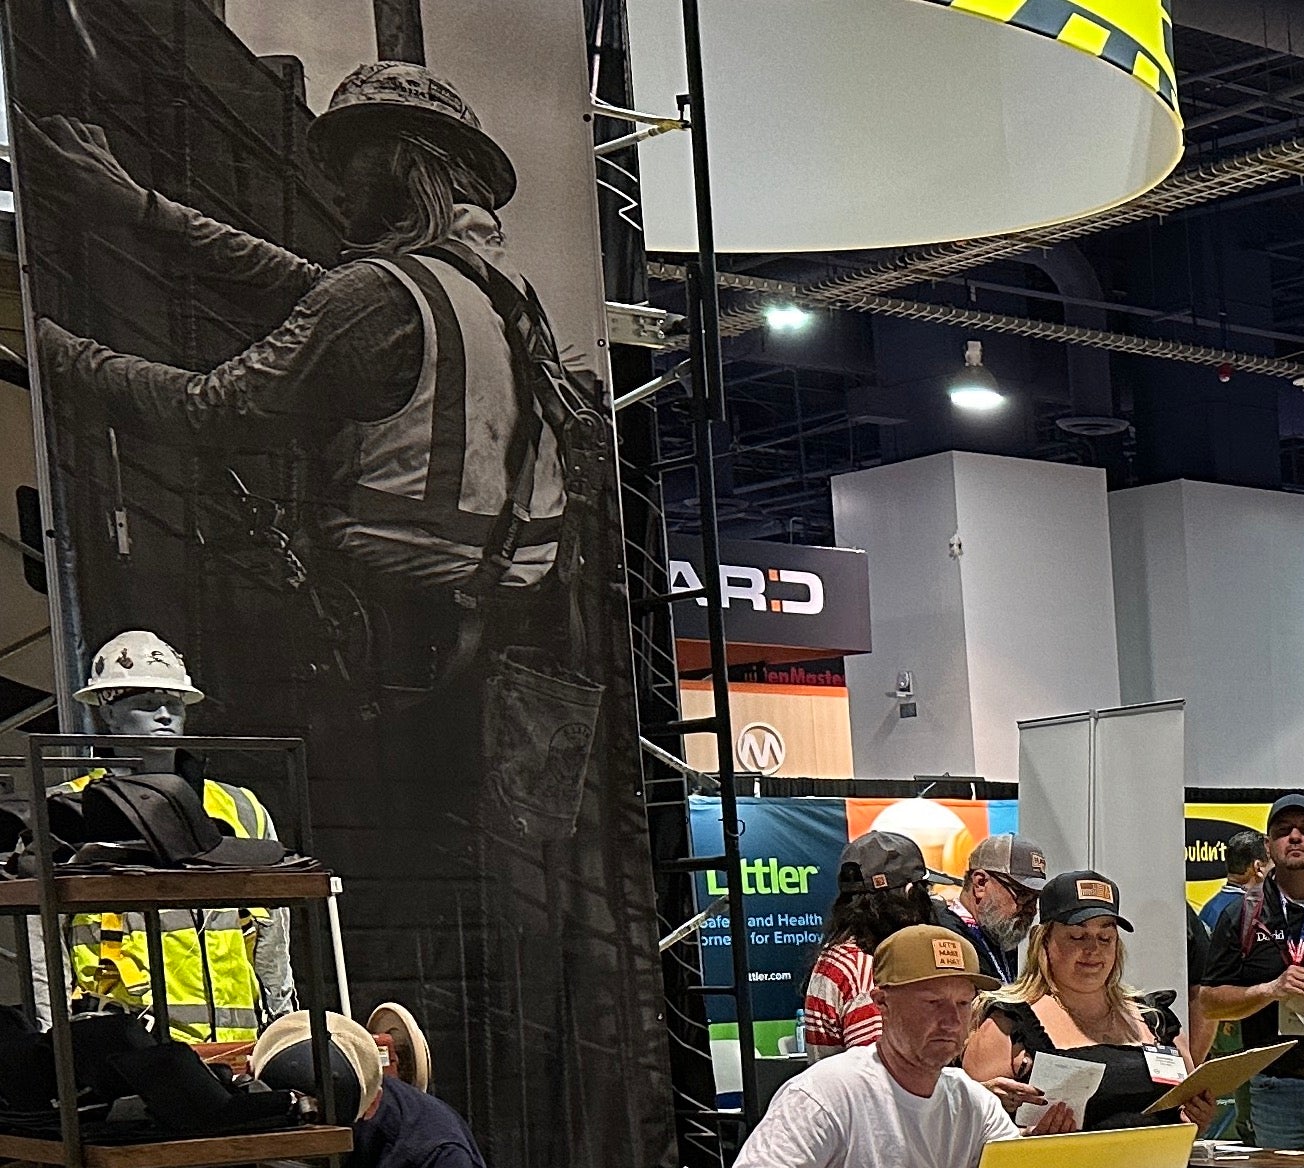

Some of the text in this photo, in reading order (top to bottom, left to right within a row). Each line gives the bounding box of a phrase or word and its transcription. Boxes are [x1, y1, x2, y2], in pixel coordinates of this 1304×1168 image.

[706, 857, 820, 896] Lttler
[747, 913, 774, 928] and
[778, 913, 823, 927] Health
[750, 931, 770, 945] for
